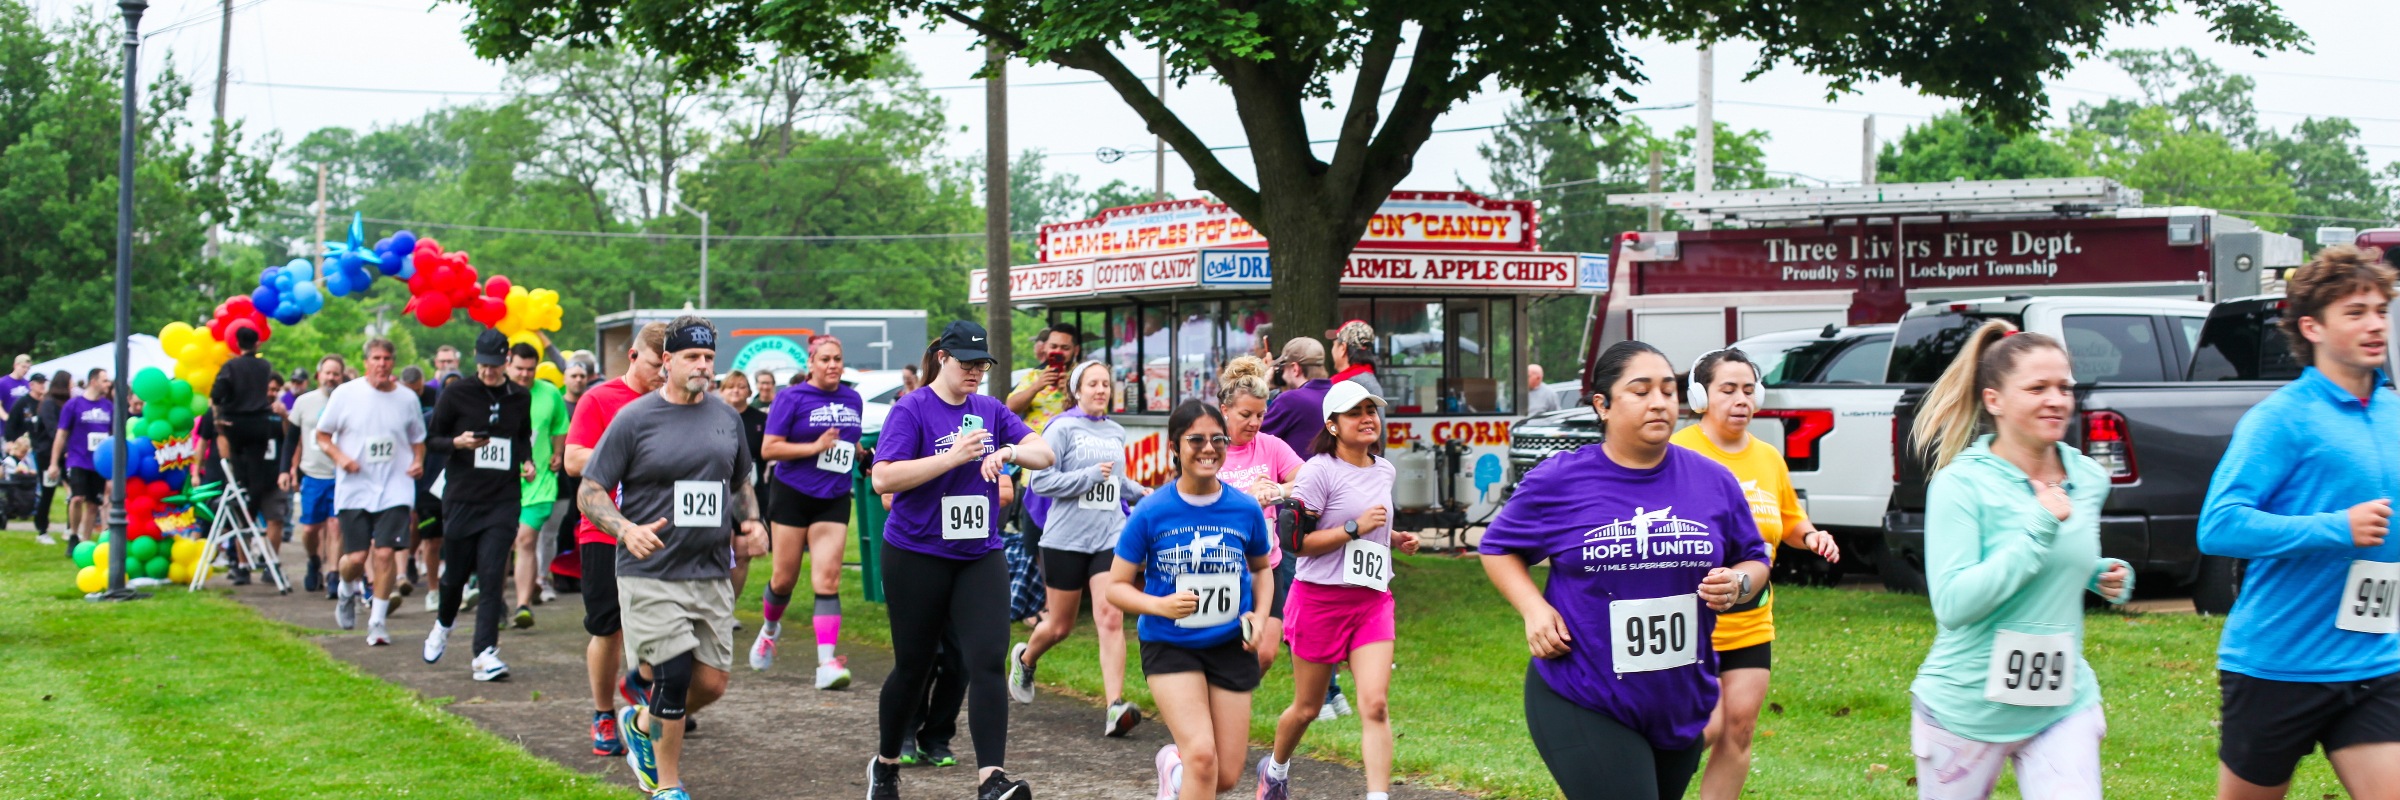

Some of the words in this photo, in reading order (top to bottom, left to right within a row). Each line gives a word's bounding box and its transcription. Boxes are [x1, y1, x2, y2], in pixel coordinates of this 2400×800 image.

[1053, 232, 1122, 257] CARMEL
[1126, 223, 1187, 249] APPLES
[1196, 218, 1226, 243] POP
[1231, 217, 1262, 241] CO
[1423, 215, 1511, 240] CANDY
[1764, 238, 1837, 262] Three
[1943, 232, 1998, 257] Fire
[2011, 230, 2082, 260] Dept.
[1097, 262, 1146, 283] COTTON
[1151, 257, 1196, 280] CANDY
[1207, 254, 1236, 277] Cold
[1341, 258, 1417, 278] ARMEL
[1423, 259, 1498, 280] APPLE
[1503, 261, 1567, 281] CHIPS
[1782, 265, 1840, 282] Proudly
[1846, 264, 1894, 280] Srvin
[1910, 261, 1979, 280] Lockport
[1985, 259, 2058, 278] Township
[1030, 268, 1083, 290] APPLES
[1431, 421, 1510, 447] CORN
[370, 442, 393, 457] 912
[481, 446, 505, 462] 881
[824, 447, 850, 466] 945
[683, 492, 717, 516] 929
[1086, 482, 1115, 503] 890
[950, 505, 984, 530] 949
[1582, 543, 1633, 560] HOPE
[1652, 540, 1714, 556] UNITED
[1353, 550, 1383, 581] 962
[1608, 563, 1628, 571] MILE
[1629, 561, 1679, 570] SUPERHERO
[1680, 560, 1698, 568] FUN
[1626, 612, 1686, 656] 950
[2004, 649, 2064, 691] 989
